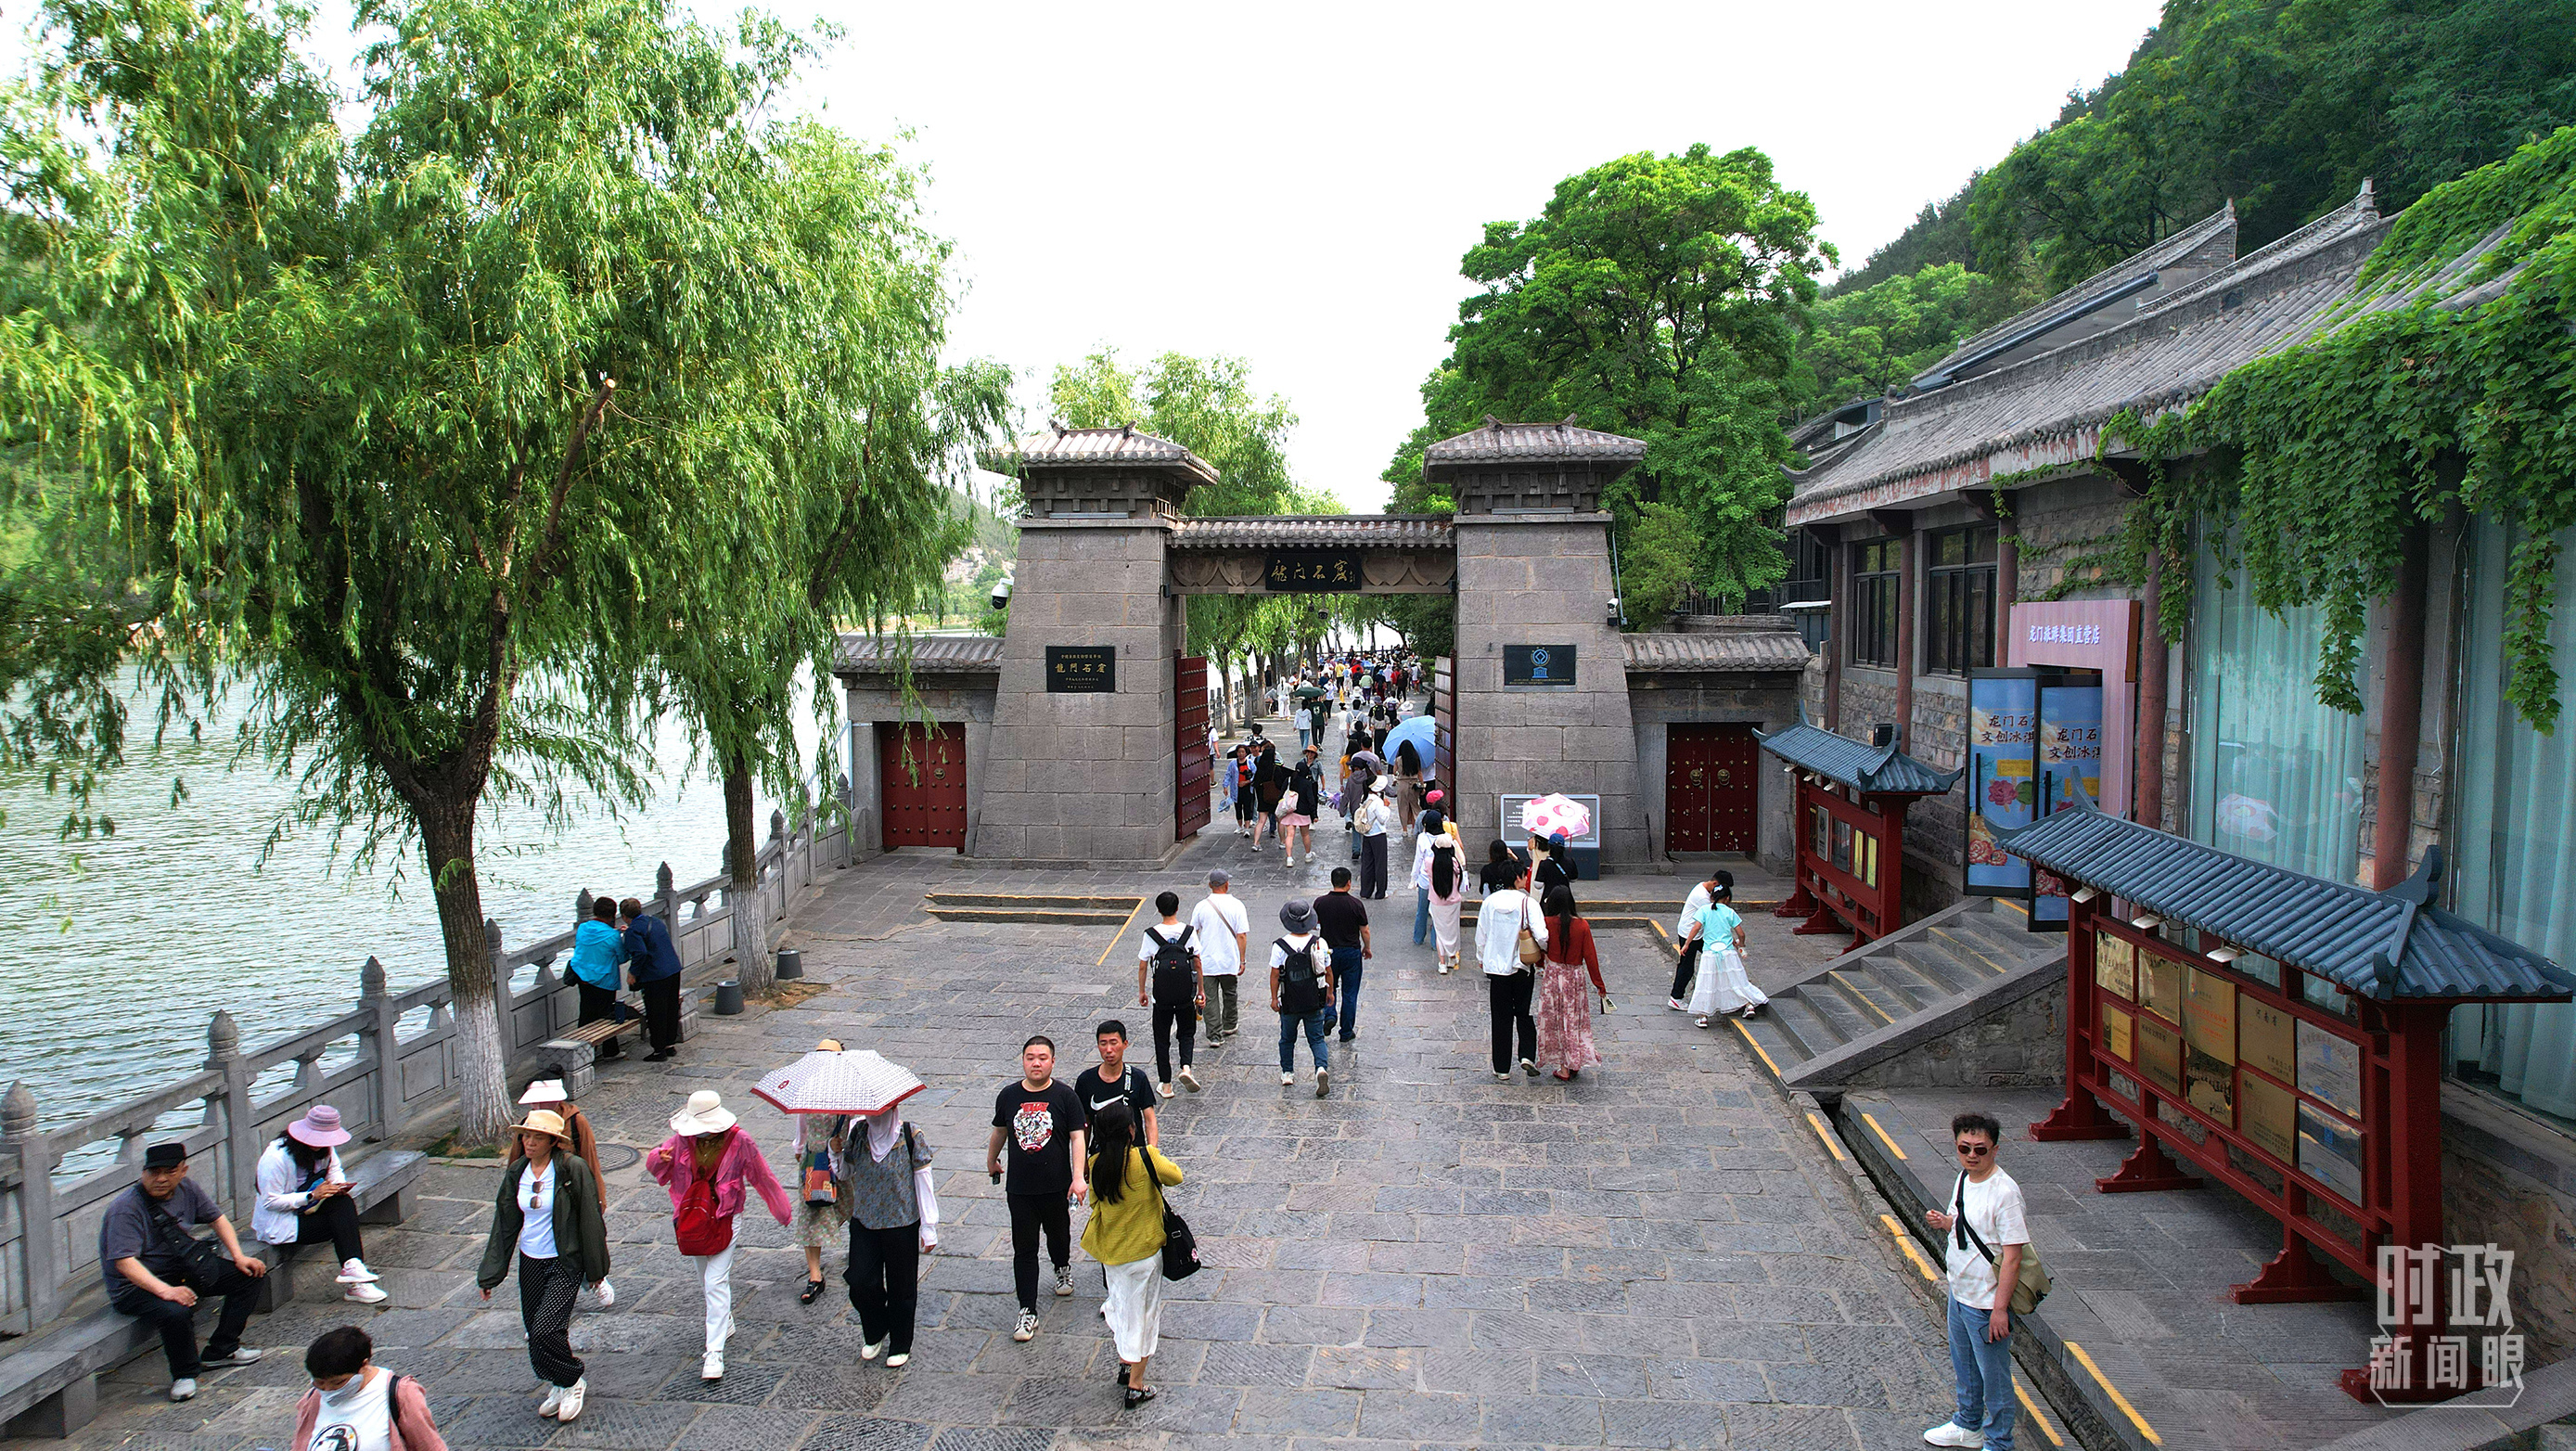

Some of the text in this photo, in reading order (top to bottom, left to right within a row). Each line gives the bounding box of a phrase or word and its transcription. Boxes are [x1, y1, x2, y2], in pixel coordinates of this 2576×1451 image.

[2028, 624, 2100, 645] 龙门旅游集团直营店
[1989, 714, 2034, 727] 龙门石
